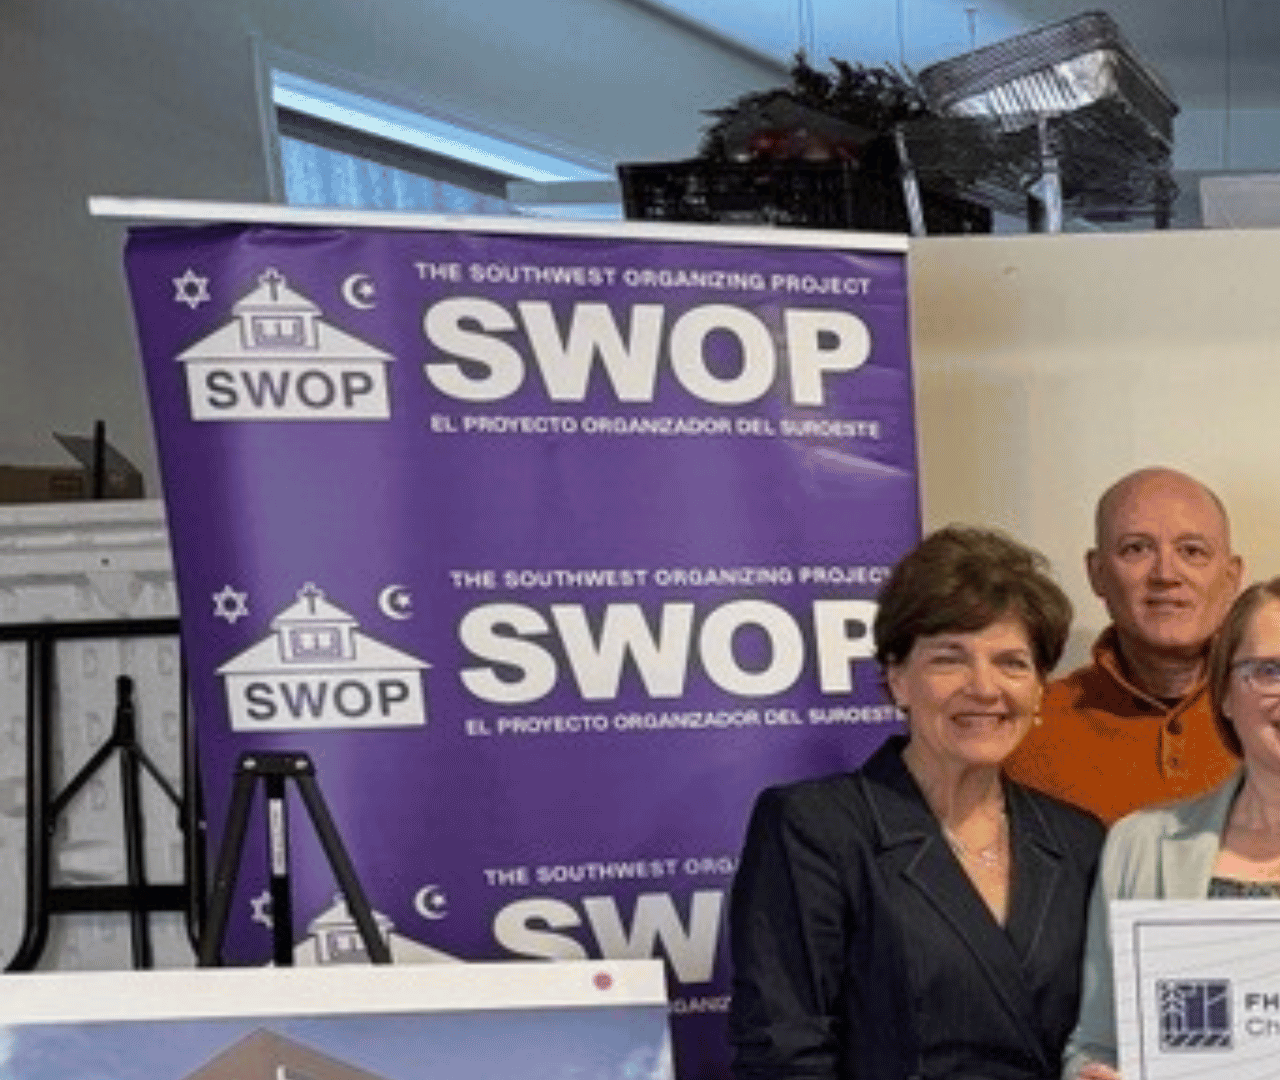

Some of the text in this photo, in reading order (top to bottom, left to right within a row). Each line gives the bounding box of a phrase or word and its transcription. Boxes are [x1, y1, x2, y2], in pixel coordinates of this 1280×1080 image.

[414, 261, 872, 295] THE SOUTHWEST ORGANIZING PROJECT
[422, 296, 872, 407] SWOP
[205, 370, 375, 410] SWOP
[430, 414, 880, 440] EL PROYECTO ORGANIZADOR DEL SUROESTE
[449, 569, 495, 589] THE
[503, 568, 648, 589] SOUTHWEST
[654, 567, 792, 588] ORGANIZING
[459, 599, 880, 703] SWOP
[245, 680, 409, 722] SWOP
[465, 718, 492, 737] EL
[497, 714, 610, 734] PROYECTO
[613, 710, 759, 731] ORGANIZADOR
[764, 707, 802, 726] DEL
[483, 866, 528, 886] THE
[535, 858, 681, 884] SOUTHWEST
[494, 890, 723, 983] SW
